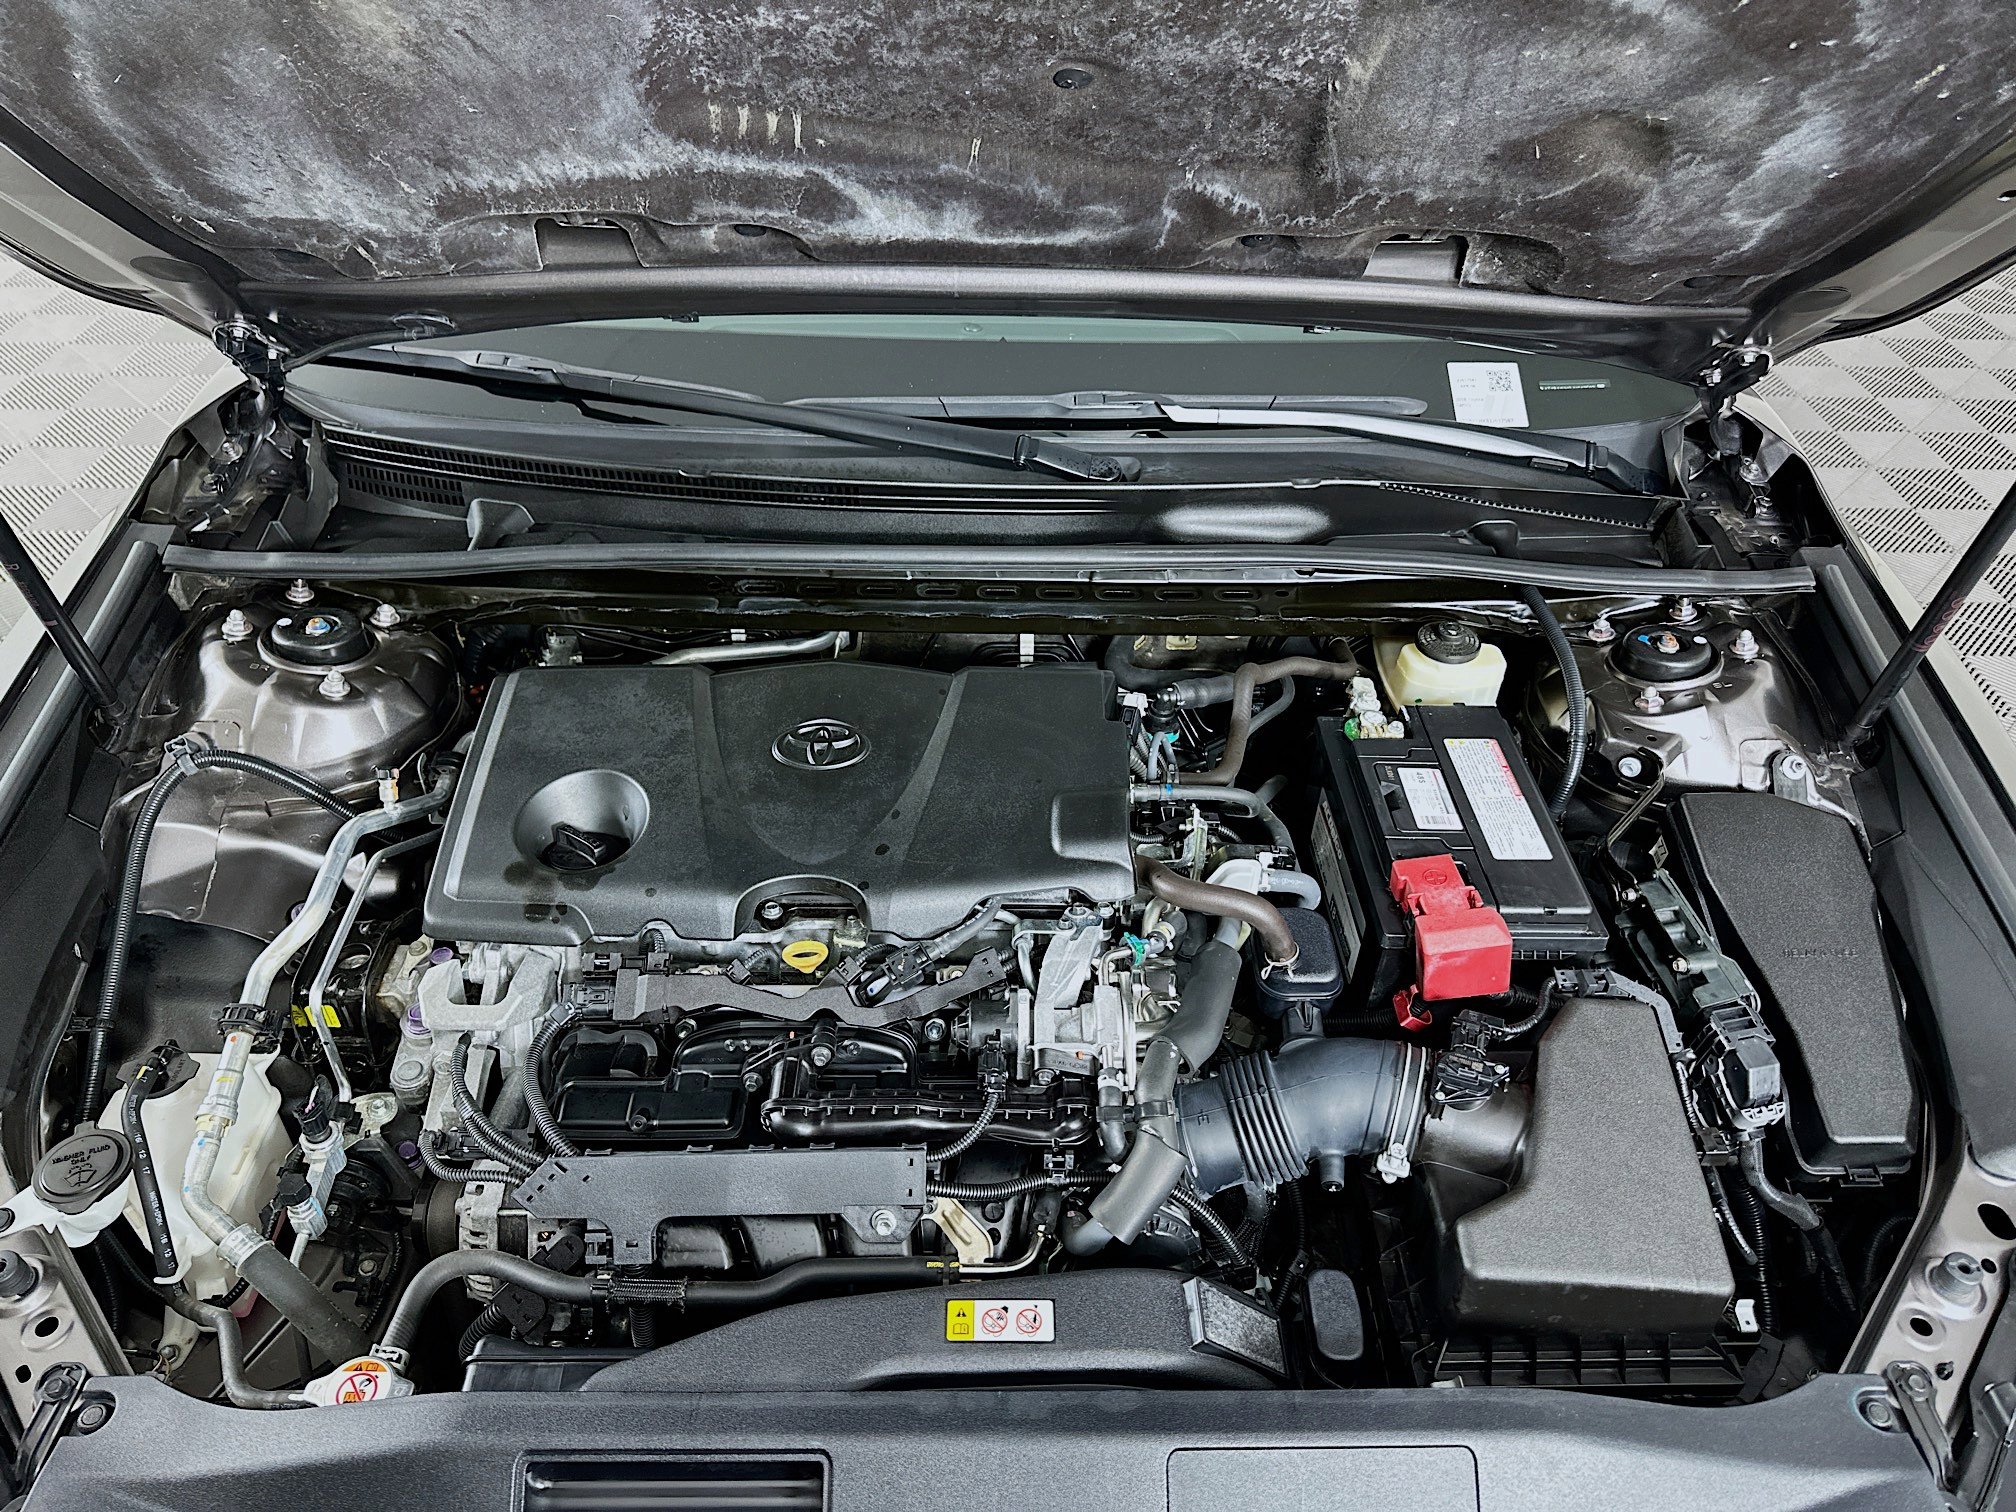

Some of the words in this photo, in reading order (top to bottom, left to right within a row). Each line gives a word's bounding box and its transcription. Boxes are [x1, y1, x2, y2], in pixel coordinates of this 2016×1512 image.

[1322, 800, 1343, 860] ACDelco
[170, 1058, 187, 1082] COOLANT
[51, 1151, 85, 1165] WASHER
[88, 1144, 111, 1155] FLUID
[138, 1149, 147, 1160] 12
[142, 1166, 151, 1175] 17
